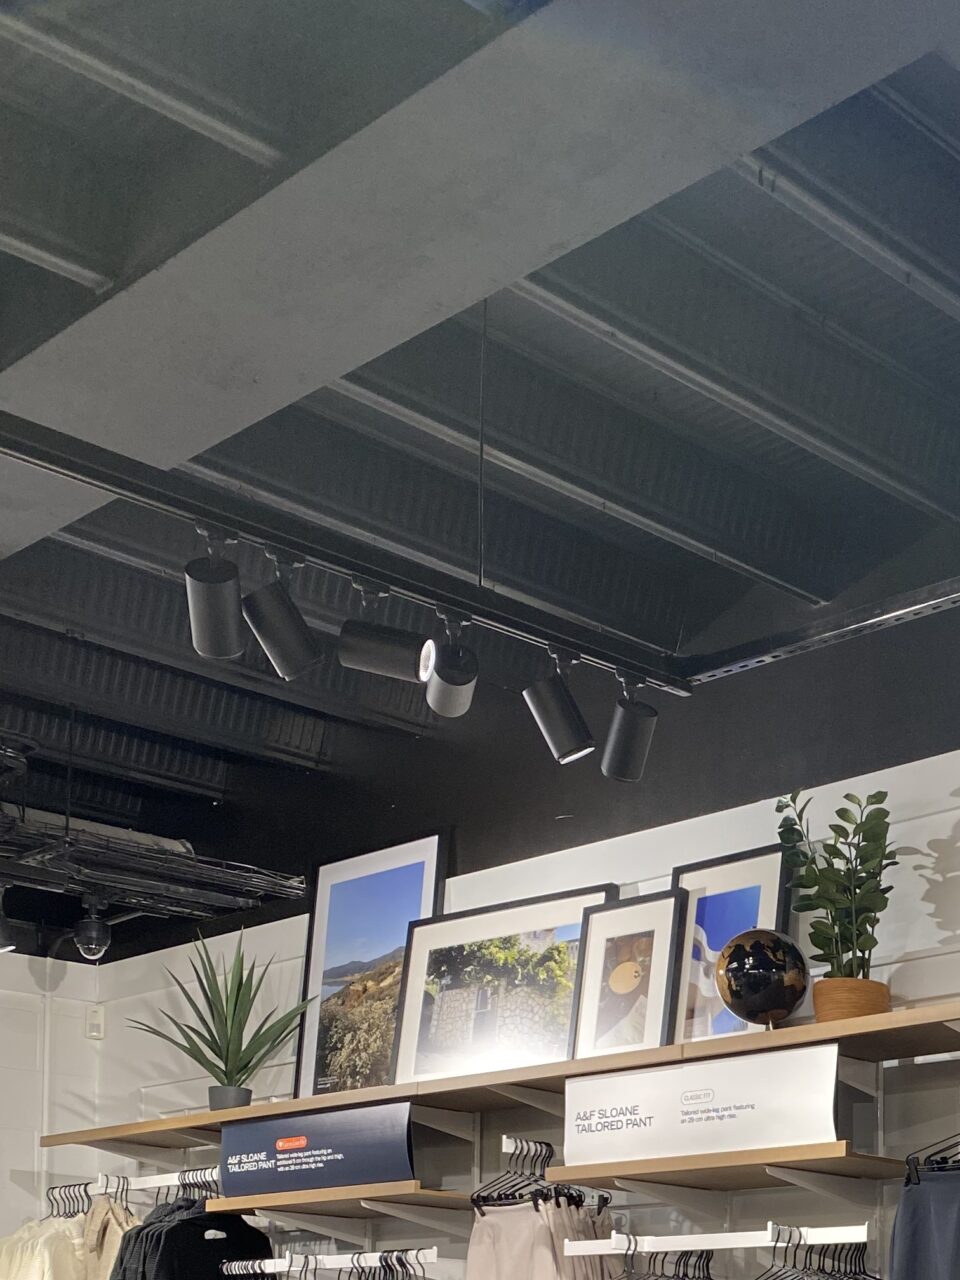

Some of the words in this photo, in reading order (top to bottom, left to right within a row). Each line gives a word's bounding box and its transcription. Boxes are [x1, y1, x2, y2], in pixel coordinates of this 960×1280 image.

[575, 1110, 597, 1122] A&F
[597, 1105, 640, 1120] SLOANE
[575, 1119, 624, 1134] TAILORED
[626, 1116, 655, 1129] PANT
[227, 1155, 240, 1165] A&F
[241, 1152, 267, 1163] SLOANE
[227, 1162, 258, 1173] TAILORED
[258, 1159, 276, 1169] PANT
